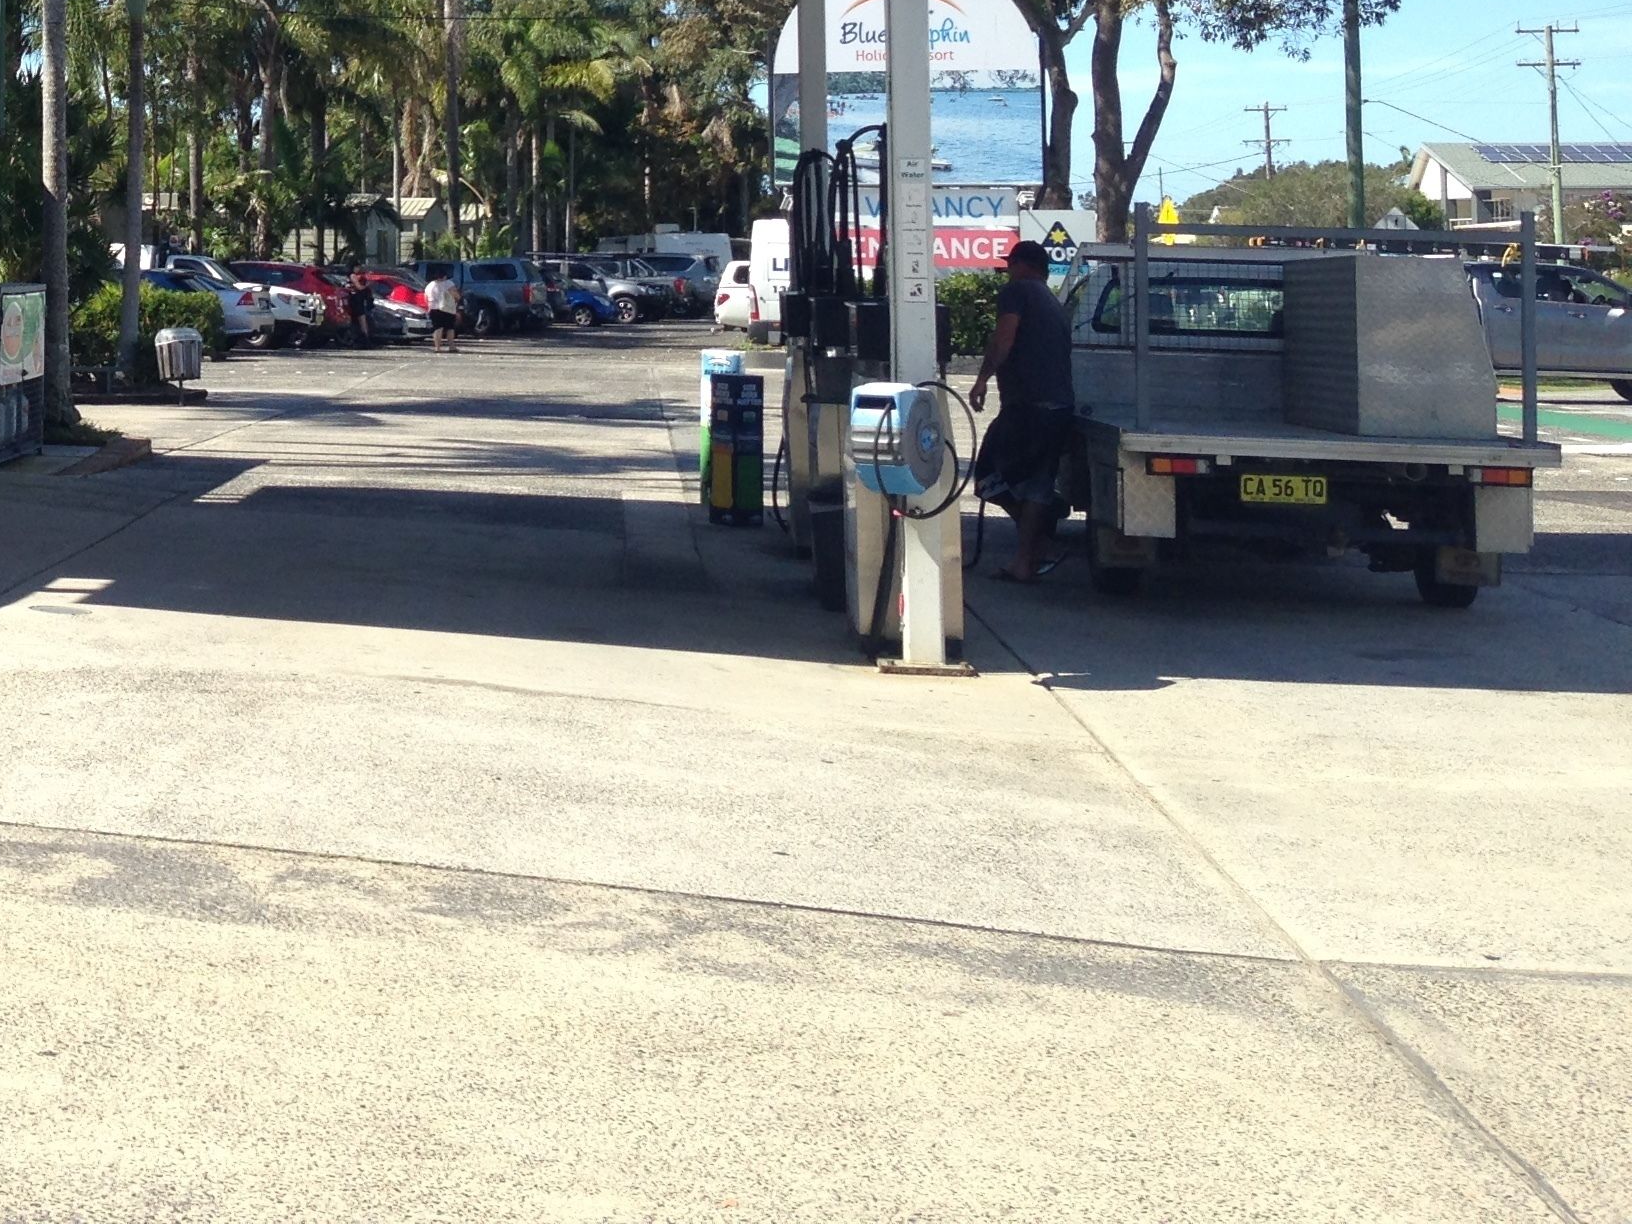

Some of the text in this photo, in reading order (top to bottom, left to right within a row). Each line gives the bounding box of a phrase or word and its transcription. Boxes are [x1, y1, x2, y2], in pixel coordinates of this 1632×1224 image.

[839, 17, 971, 50] Blue phin
[856, 49, 955, 62] Holi sort
[906, 160, 918, 168] Air
[901, 171, 925, 179] Water
[864, 194, 1005, 219] VANCY
[851, 236, 1009, 261] ENANCE
[1243, 477, 1266, 496] CA
[1272, 478, 1294, 497] 56
